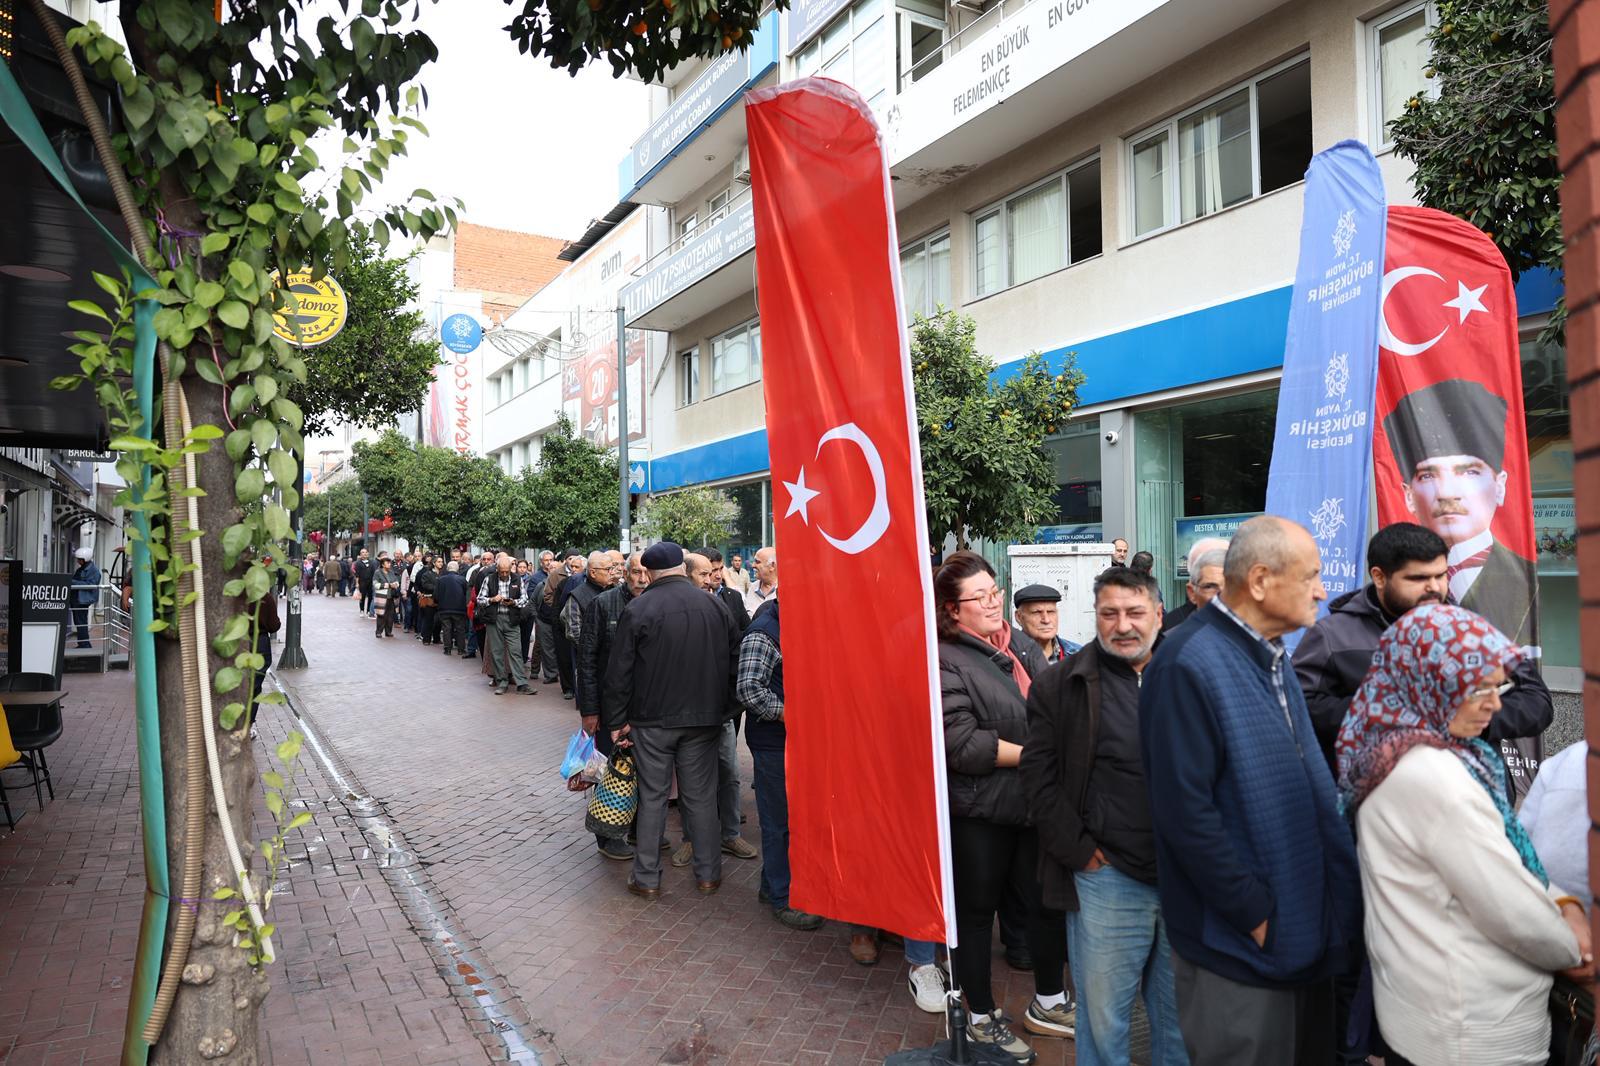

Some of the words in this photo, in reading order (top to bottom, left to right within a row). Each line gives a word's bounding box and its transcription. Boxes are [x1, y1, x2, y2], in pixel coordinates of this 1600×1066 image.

[1048, 2, 1062, 29] EN
[981, 50, 994, 72] EN
[996, 25, 1030, 62] BÜYÜK
[953, 65, 1010, 115] FELEMENKÇE
[601, 250, 621, 280] avm
[1194, 523, 1214, 532] DESTEK
[31, 601, 66, 610] Perfume
